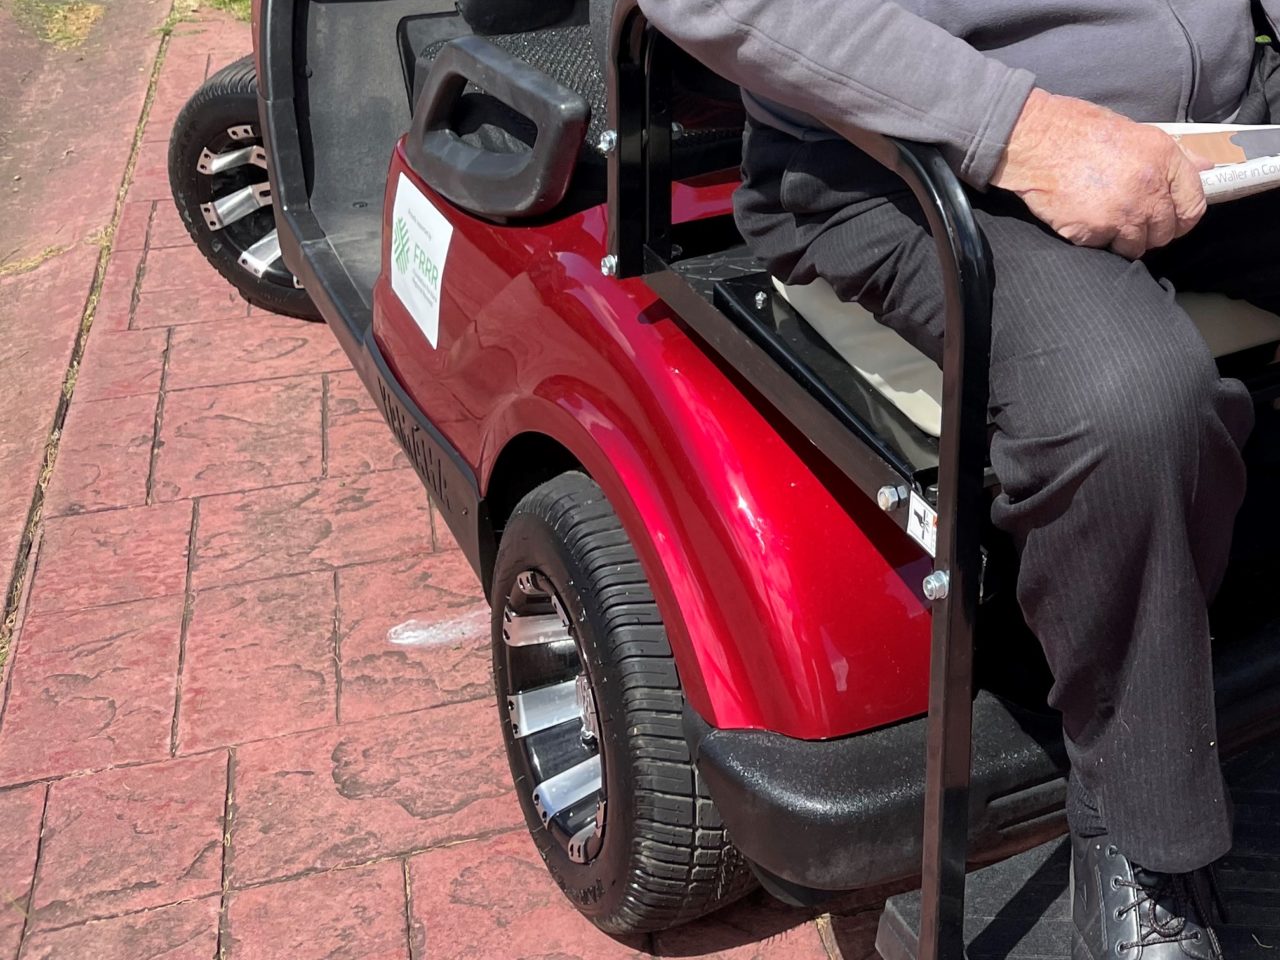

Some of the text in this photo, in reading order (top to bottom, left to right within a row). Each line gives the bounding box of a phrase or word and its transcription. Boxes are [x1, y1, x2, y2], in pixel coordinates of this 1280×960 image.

[1216, 170, 1247, 184] Waller
[1251, 167, 1260, 178] in
[413, 243, 439, 290] FRRR
